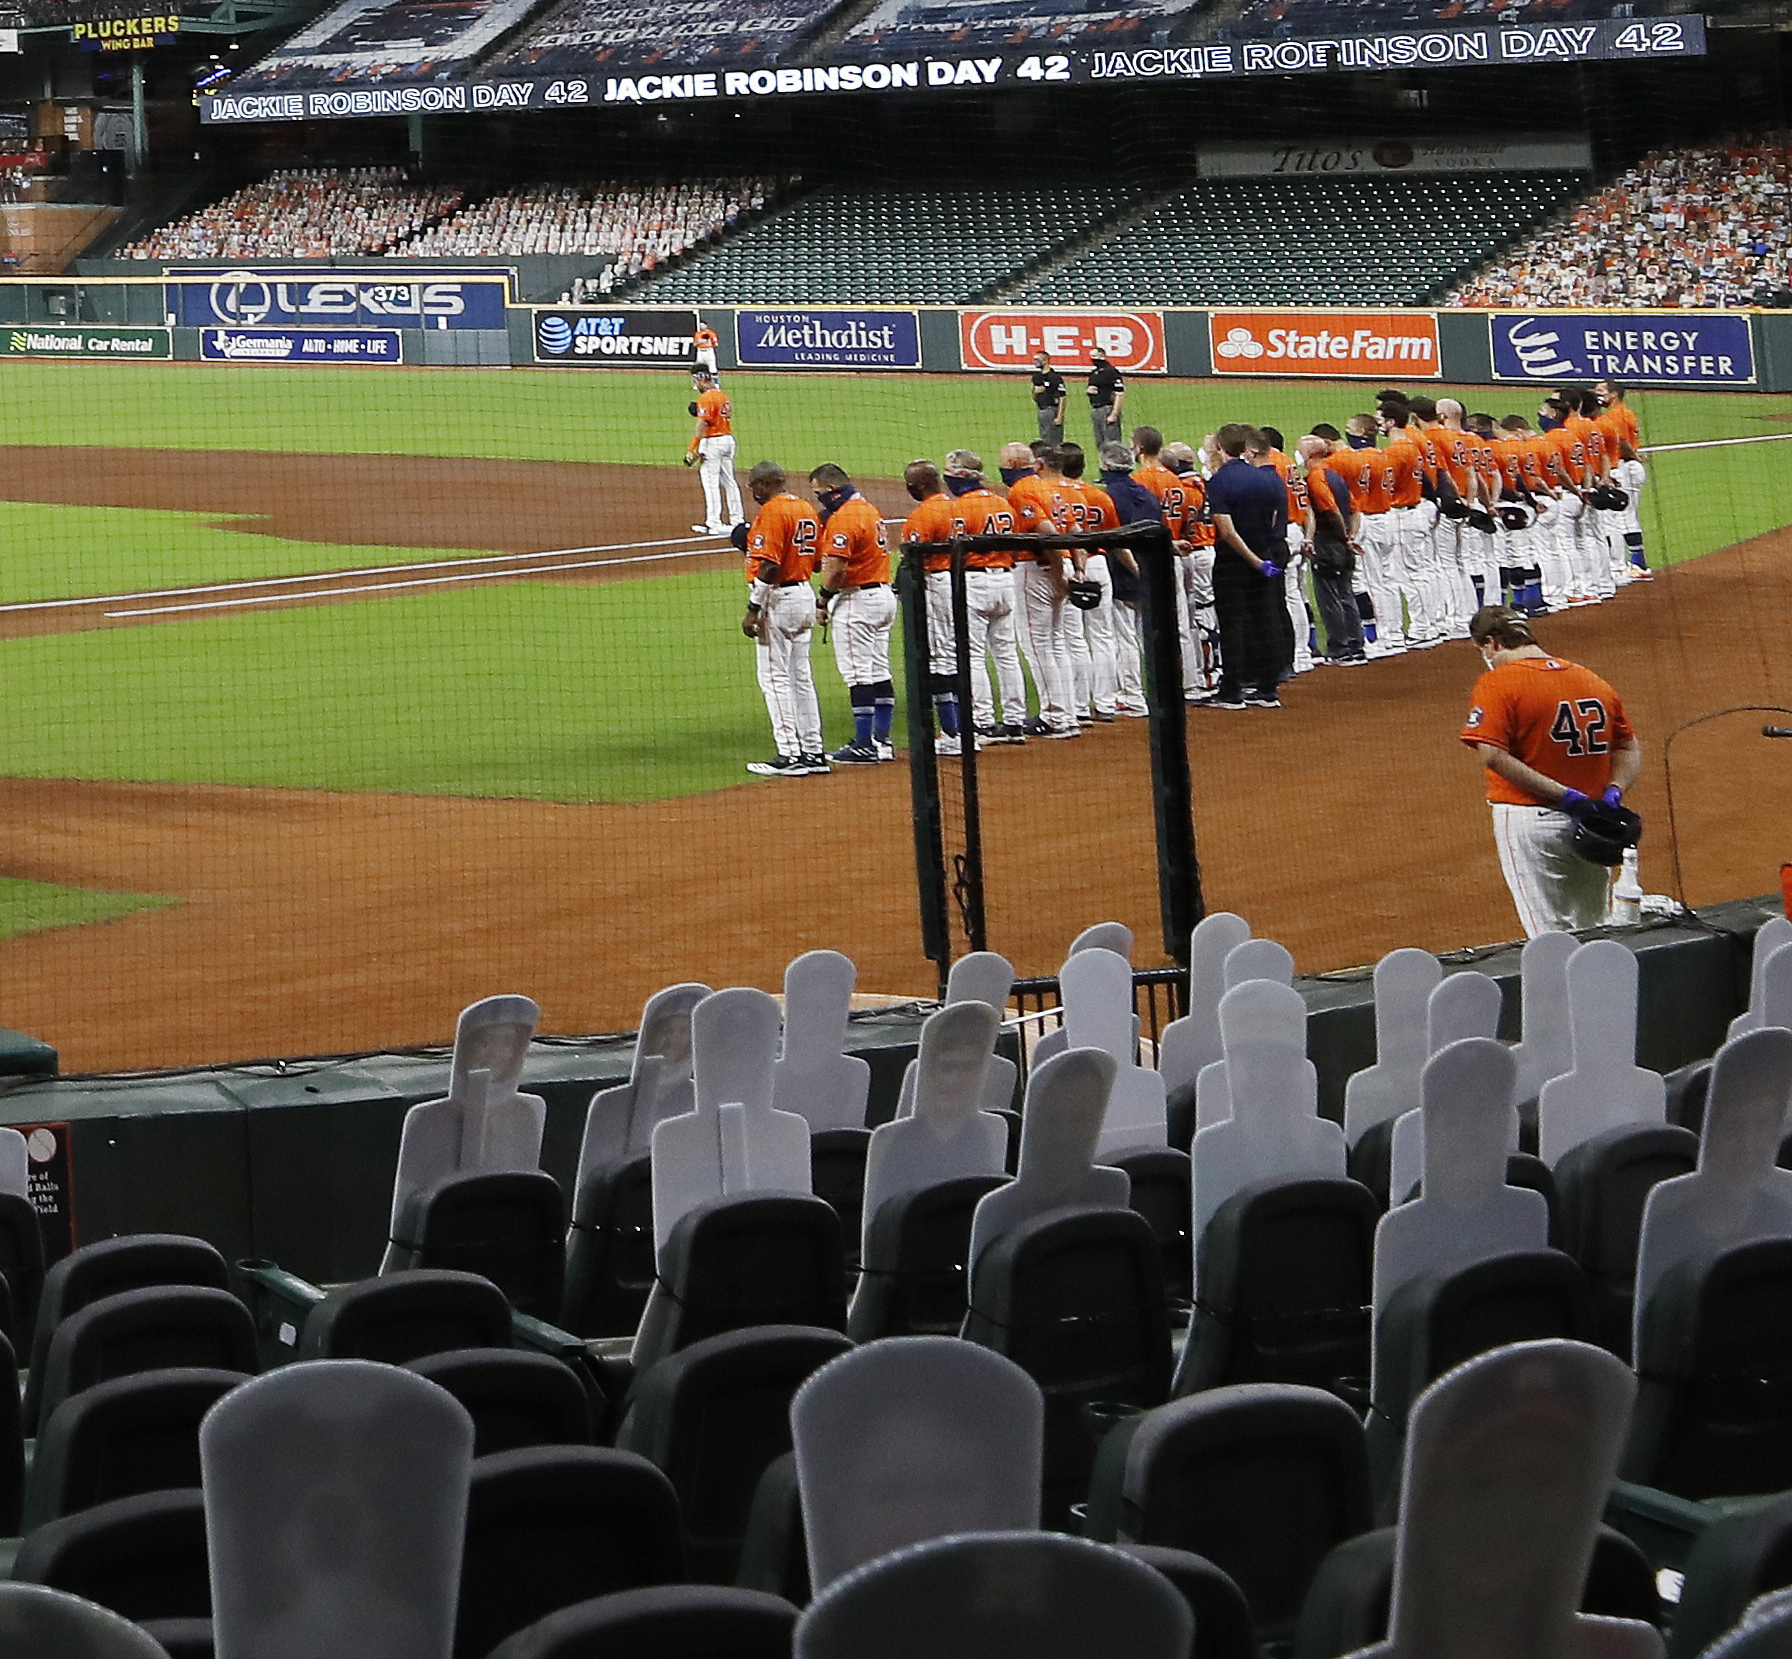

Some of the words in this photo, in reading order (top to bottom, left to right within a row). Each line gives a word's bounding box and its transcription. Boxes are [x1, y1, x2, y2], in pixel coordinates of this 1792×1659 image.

[74, 15, 181, 39] PLUCKERS
[101, 39, 131, 51] WING
[133, 37, 154, 48] BAR
[1090, 47, 1233, 78] JACKIE
[1501, 26, 1597, 58] DAY
[1615, 22, 1685, 52] 42
[602, 68, 718, 102] JACKIE
[725, 62, 920, 97] ROBINSON
[926, 59, 1003, 88] DAY
[1016, 54, 1071, 81] 42
[211, 93, 304, 120] JACKIE
[309, 87, 466, 114] ROBINSON
[472, 82, 533, 108] DAY
[544, 79, 589, 103] 42
[1270, 145, 1364, 174] Tito's
[276, 283, 466, 316] LEXUS
[374, 285, 410, 302] 373
[574, 317, 626, 337] AT&T
[755, 314, 810, 325] HOUSTON
[26, 333, 83, 351] National
[87, 337, 110, 351] Car
[111, 337, 154, 352] Rental
[236, 334, 294, 350] Germania
[301, 337, 327, 353] AUTO
[333, 337, 361, 354] HOME
[367, 338, 387, 355] LIFE
[573, 336, 694, 357] SPORTSNET
[756, 321, 895, 349] Methodist
[989, 324, 1134, 357] H-E-B
[1584, 330, 1700, 351] ENERGY
[1585, 353, 1735, 376] TRANSFER
[1549, 697, 1609, 758] 42
